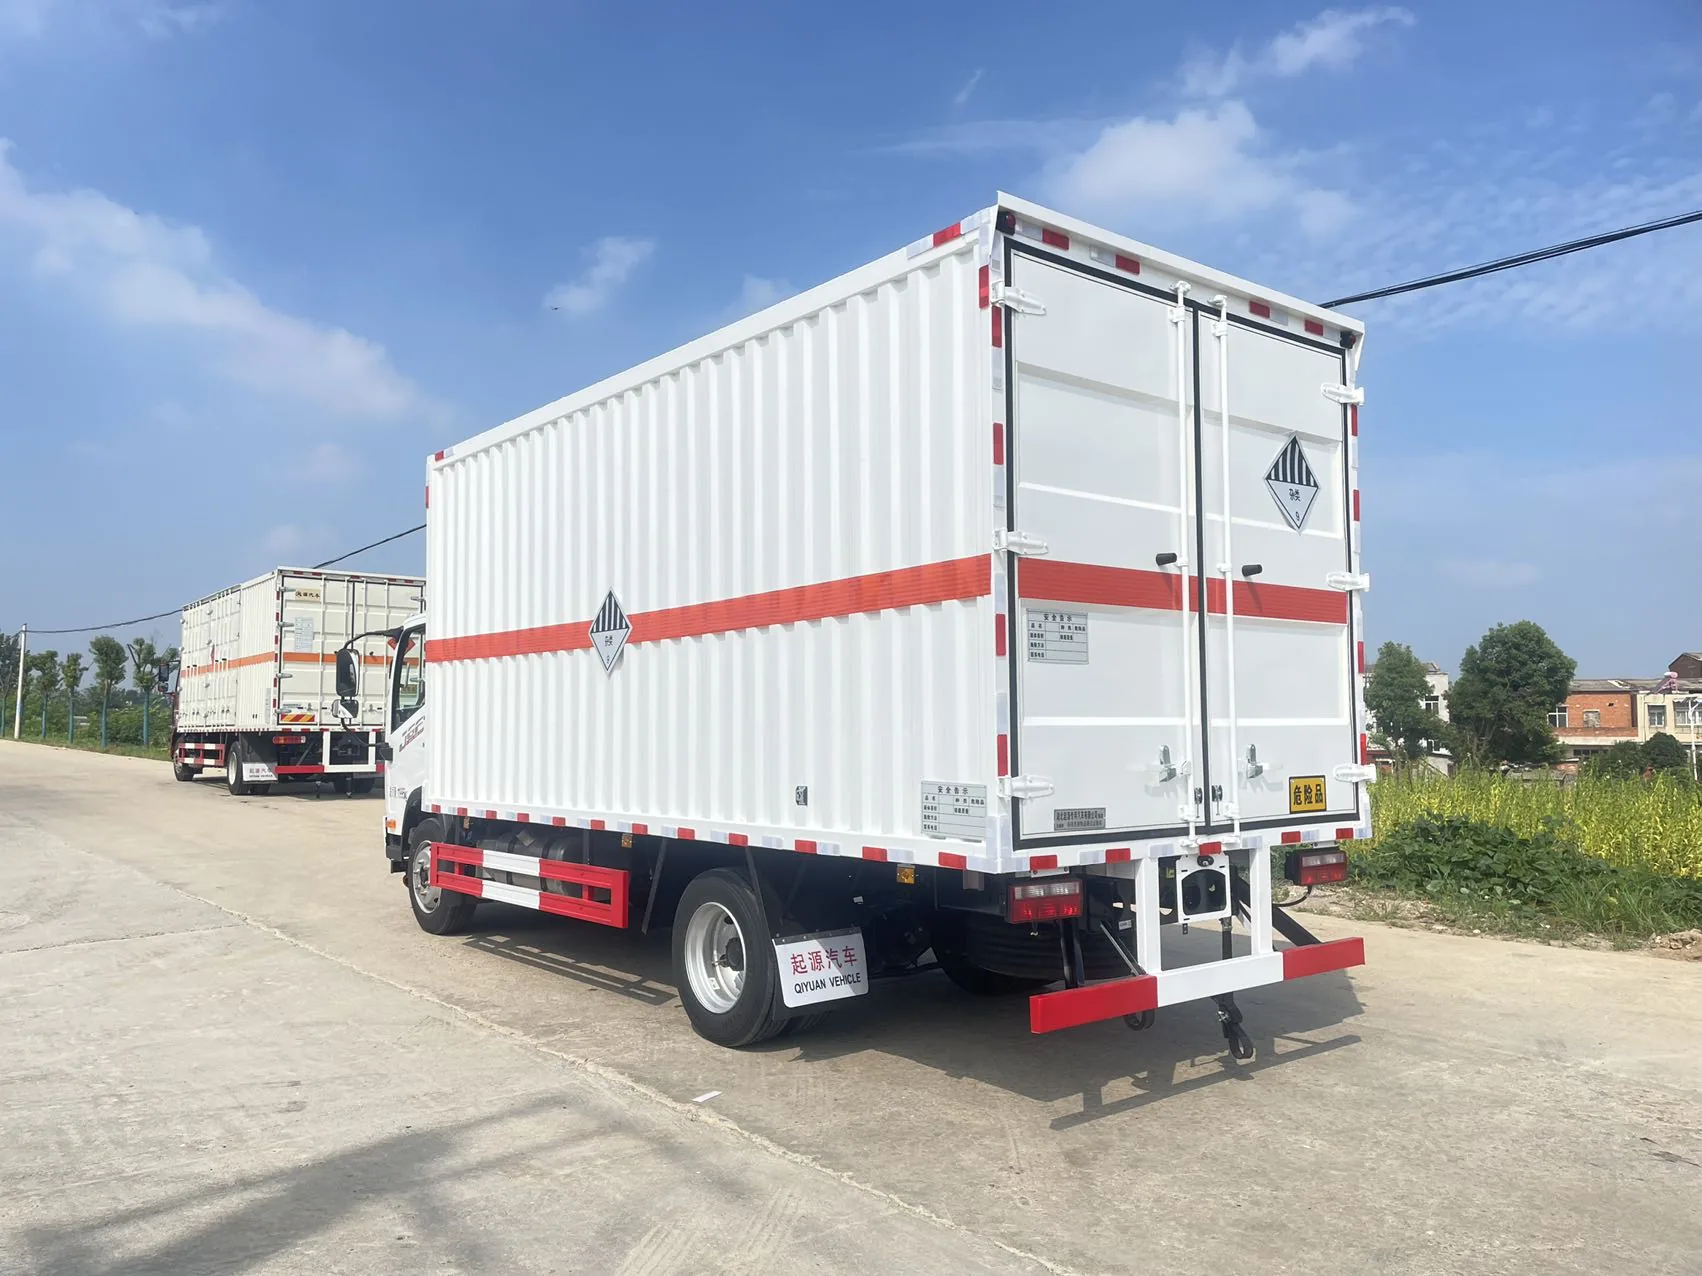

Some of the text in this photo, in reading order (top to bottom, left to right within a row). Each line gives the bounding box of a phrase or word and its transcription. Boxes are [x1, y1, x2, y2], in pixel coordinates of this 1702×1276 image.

[1043, 613, 1073, 622] 安全告示
[937, 785, 969, 795] 安全告示
[1293, 784, 1324, 806] 危险品
[790, 945, 858, 976] 起源汽车
[794, 972, 862, 995] QIYUAN VEHICLE
